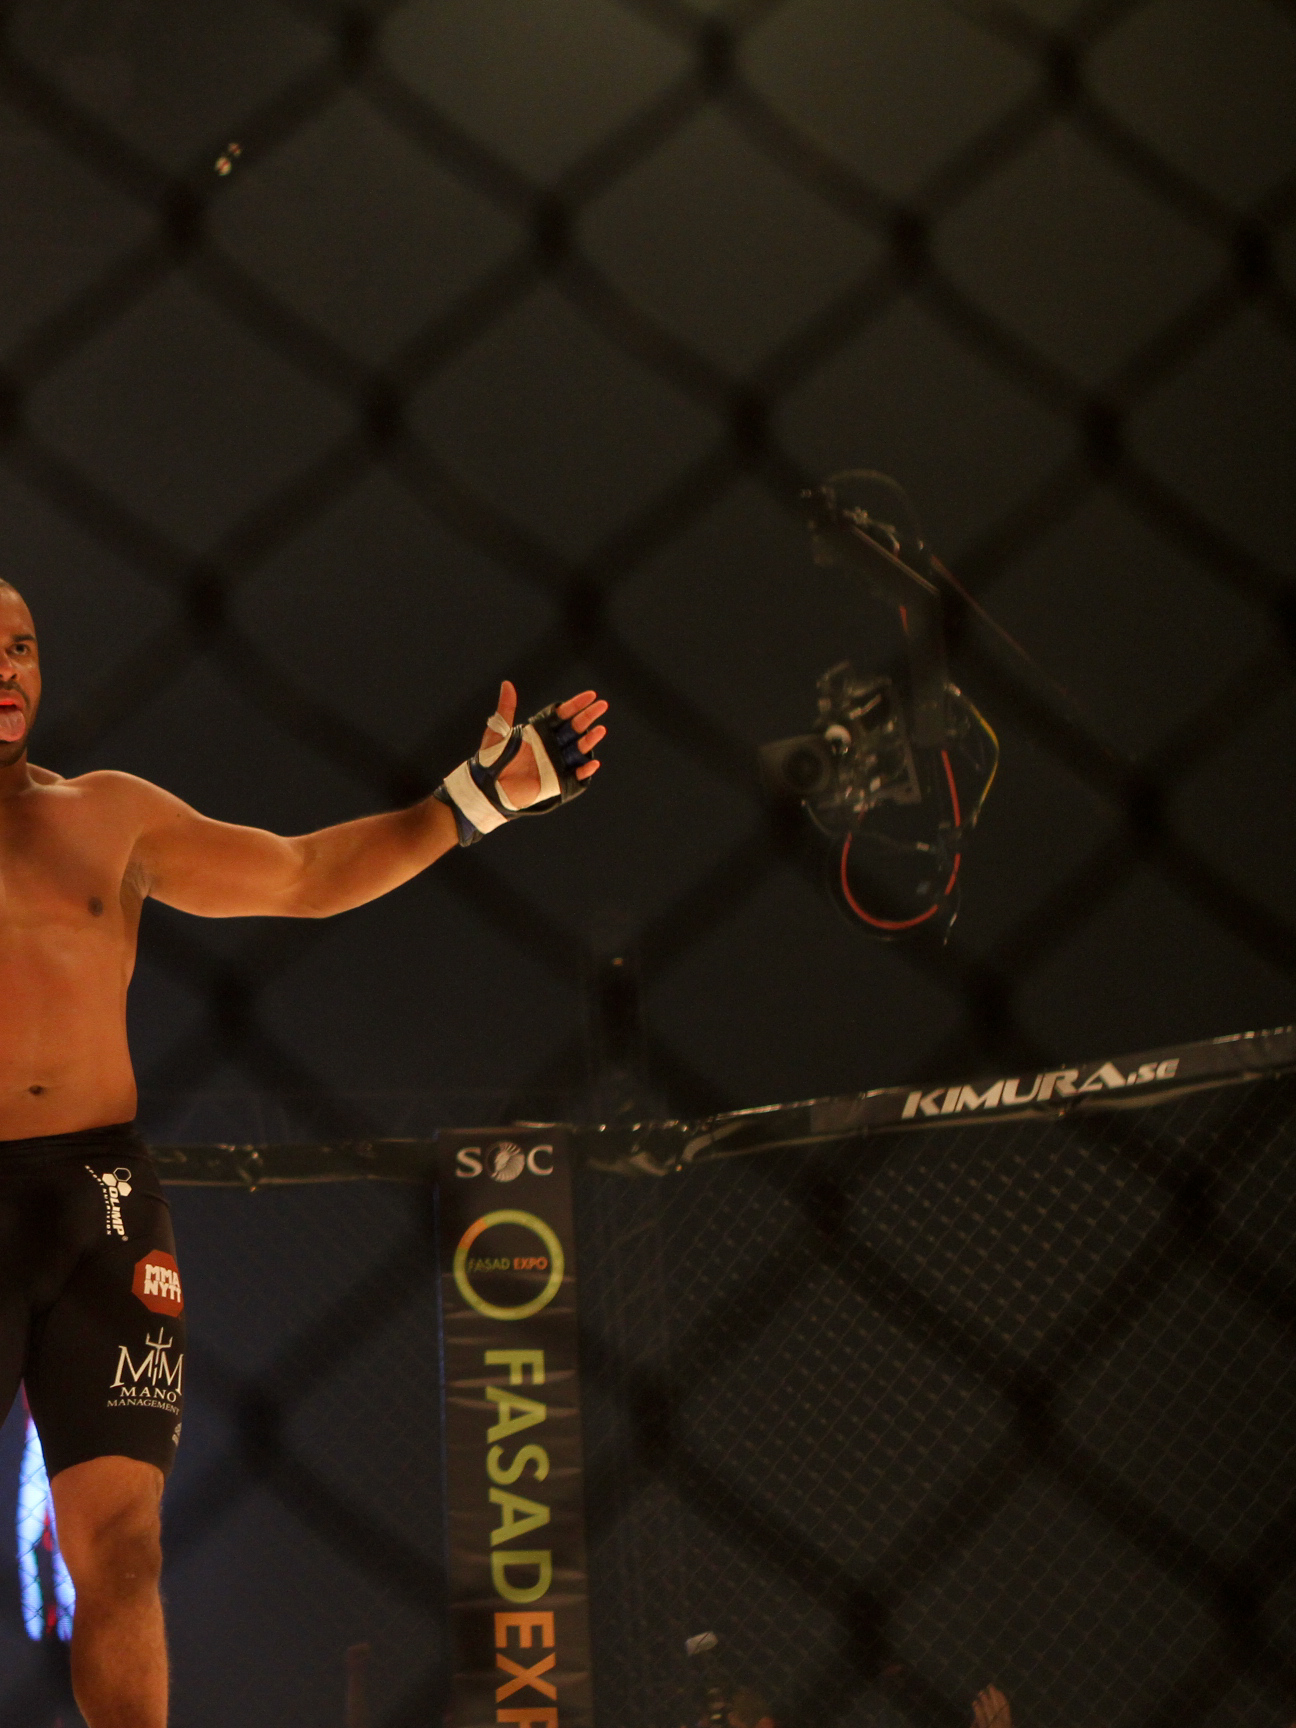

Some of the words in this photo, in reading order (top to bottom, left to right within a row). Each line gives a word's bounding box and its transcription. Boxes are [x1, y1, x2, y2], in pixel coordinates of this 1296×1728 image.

[468, 1257, 510, 1273] FASAD
[513, 1256, 549, 1270] EXPO
[145, 1264, 181, 1288] MMA
[144, 1279, 182, 1303] NYTT
[120, 1386, 178, 1403] MANO
[107, 1398, 181, 1416] MANAGEMENT
